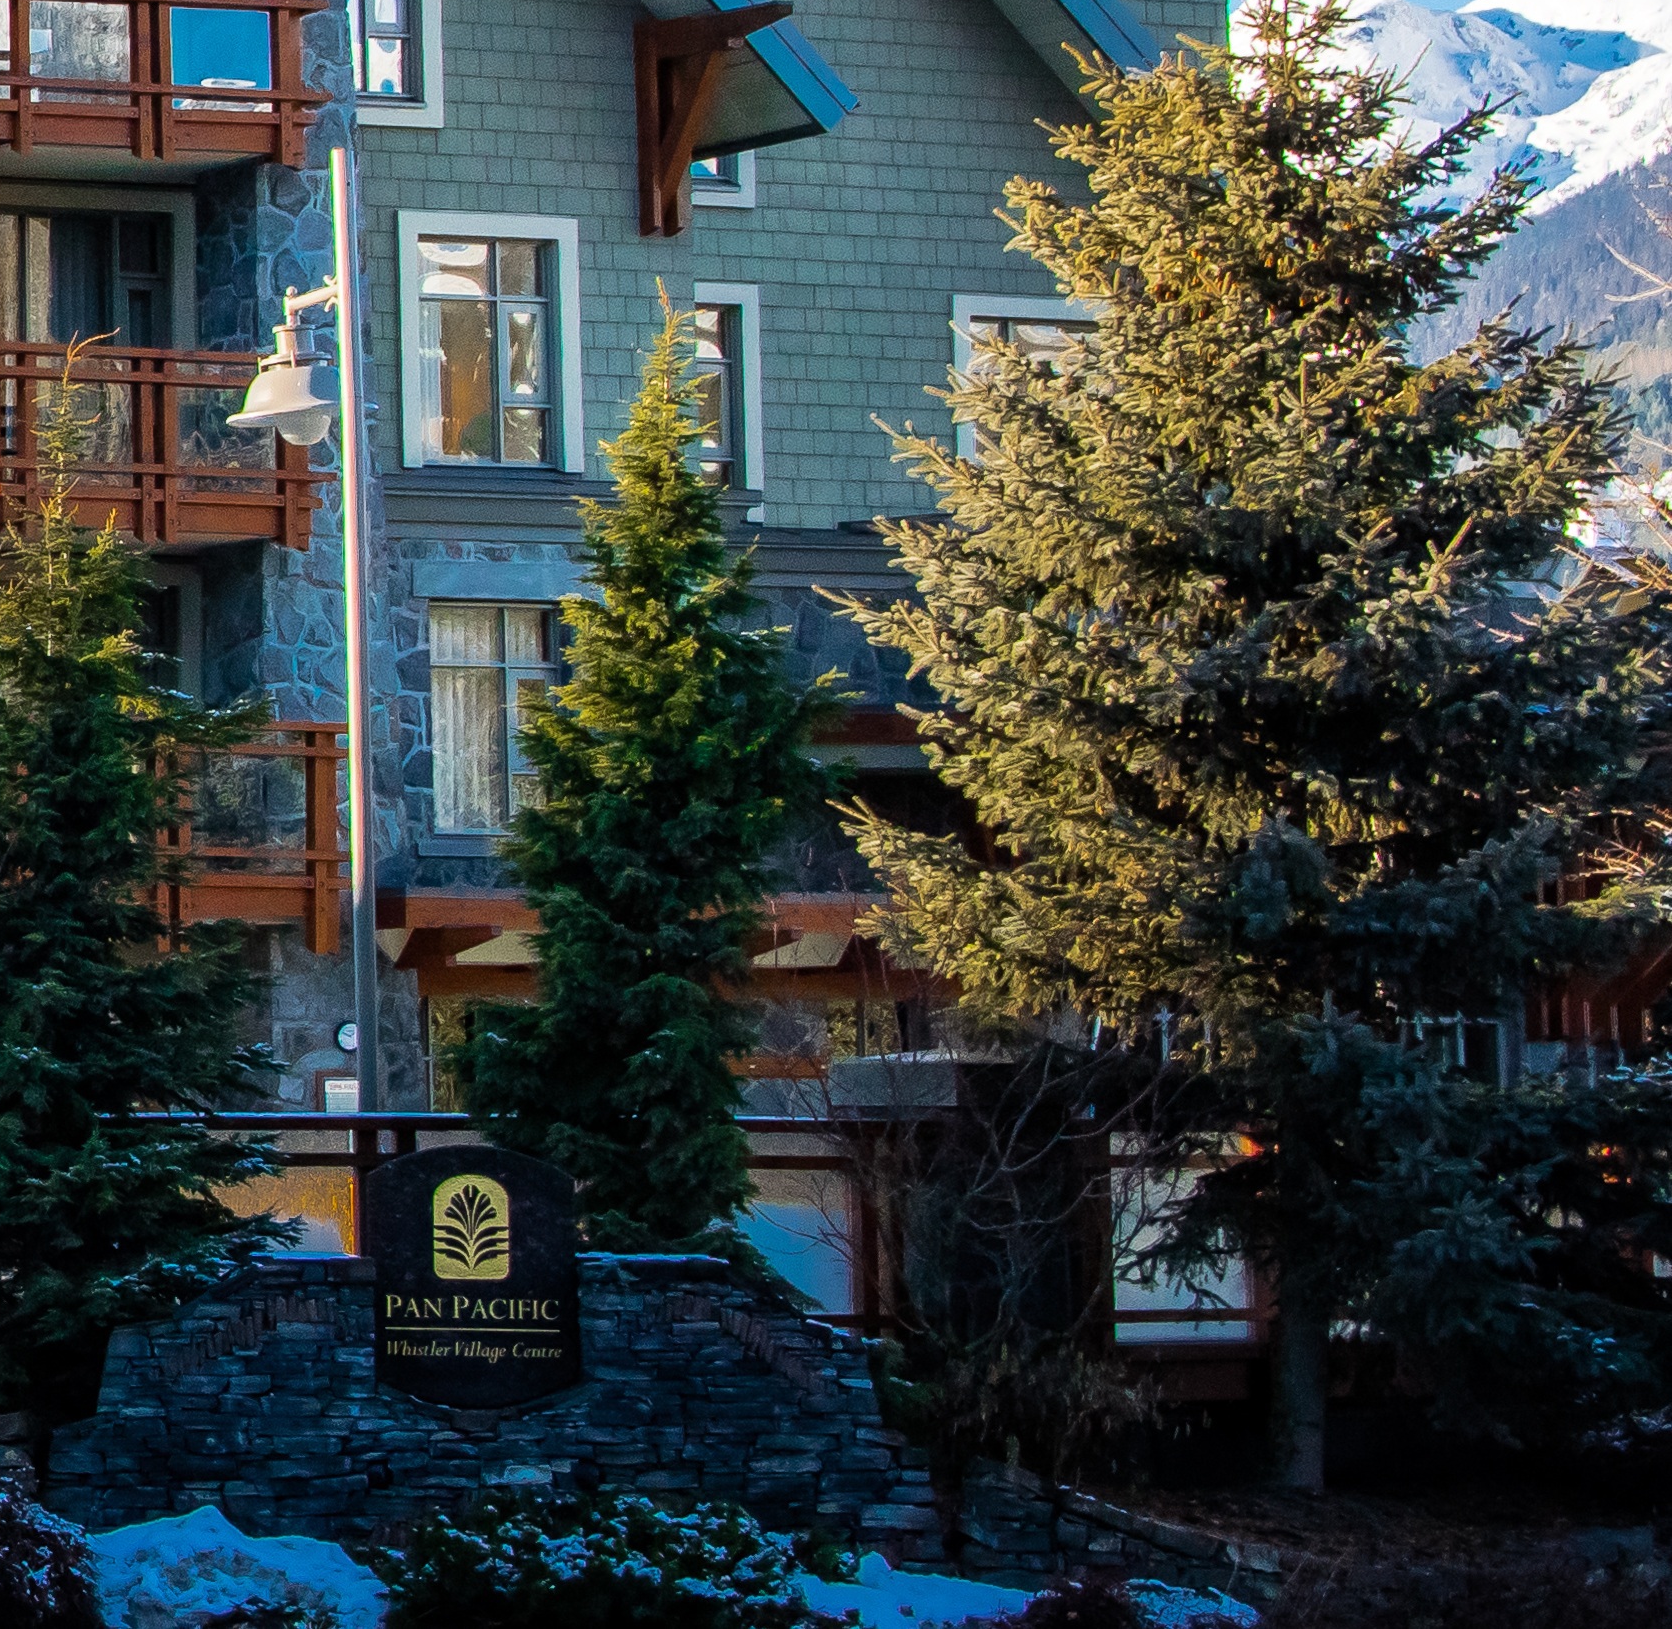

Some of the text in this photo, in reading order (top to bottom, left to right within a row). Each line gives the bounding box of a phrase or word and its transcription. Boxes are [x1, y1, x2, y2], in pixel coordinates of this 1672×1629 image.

[385, 1294, 559, 1320] PAN PACIFIC
[387, 1340, 562, 1364] Whistler Village Centre
